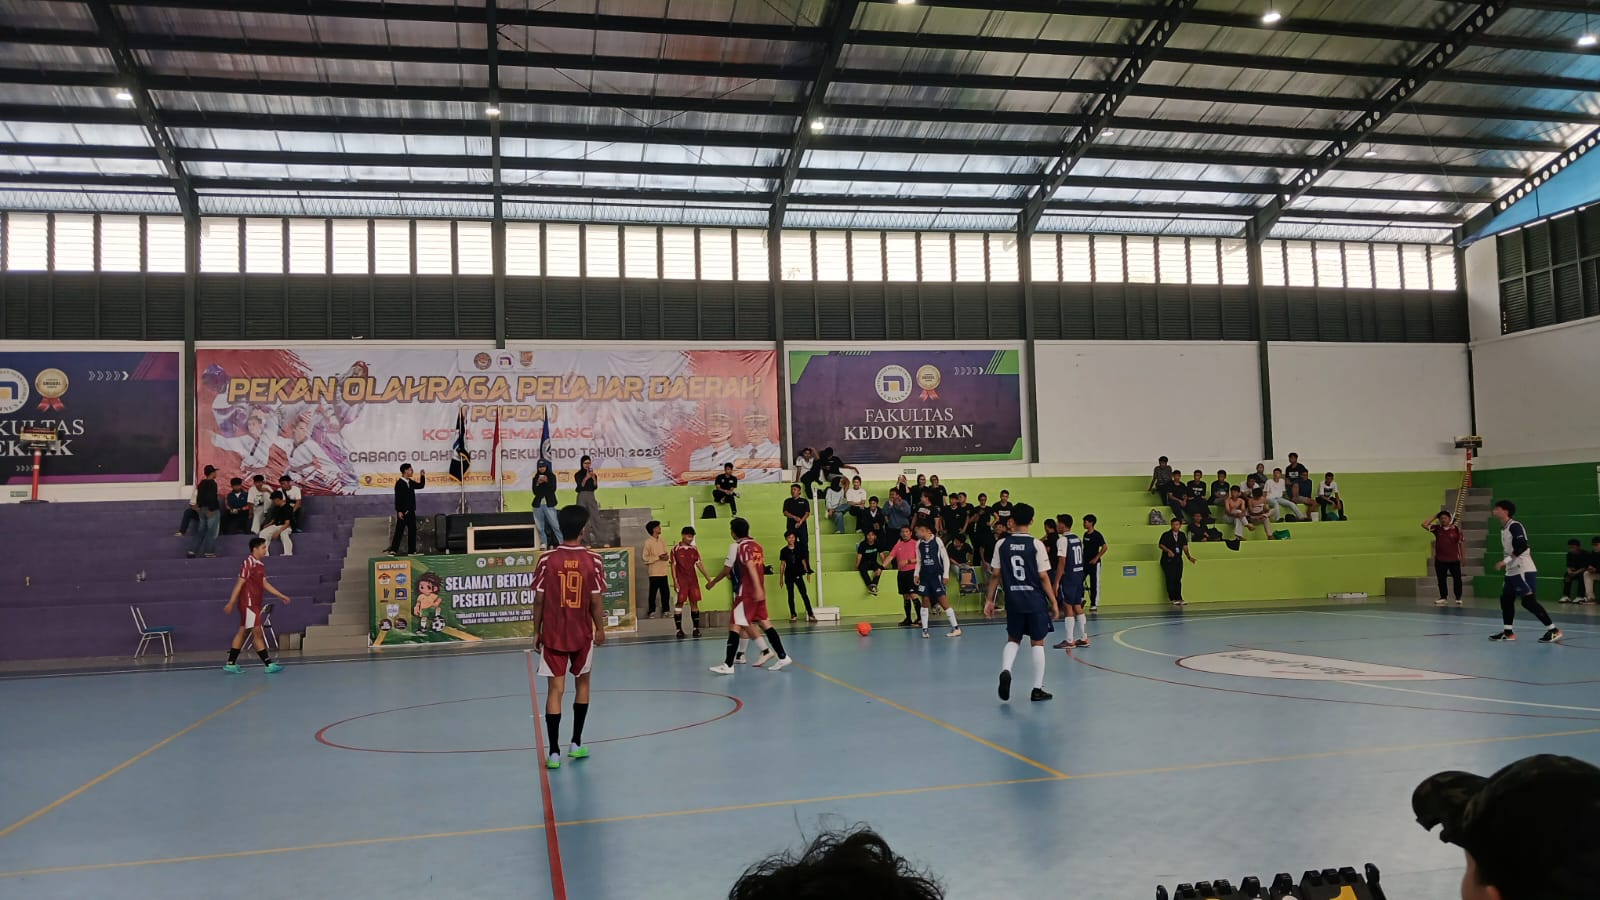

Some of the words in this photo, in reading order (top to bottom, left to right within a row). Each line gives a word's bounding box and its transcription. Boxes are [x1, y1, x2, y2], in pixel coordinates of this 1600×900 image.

[228, 376, 337, 403] PEKAN
[342, 376, 511, 404] OLAHRAGA
[516, 376, 643, 402] PELAJAR
[648, 375, 762, 401] DAERAH
[865, 408, 953, 422] FAKULTAS
[844, 425, 974, 440] KEDOKTERAN
[350, 450, 407, 463] CABANG
[580, 447, 625, 458] TAHUN
[1072, 545, 1083, 565] 10
[1011, 555, 1026, 581] 6
[445, 575, 494, 591] SELAMAT
[558, 571, 583, 608] 19
[452, 592, 498, 608] PESERTA
[500, 591, 517, 605] FIX
